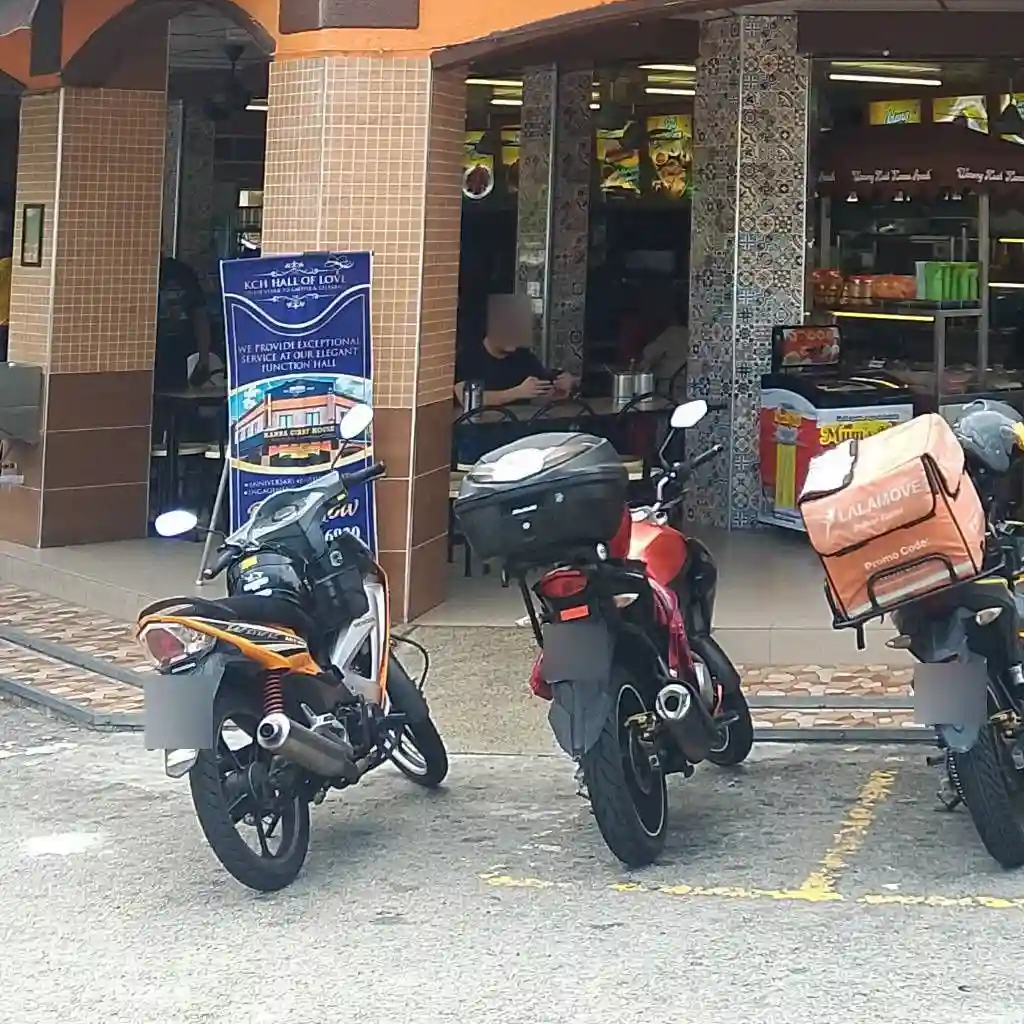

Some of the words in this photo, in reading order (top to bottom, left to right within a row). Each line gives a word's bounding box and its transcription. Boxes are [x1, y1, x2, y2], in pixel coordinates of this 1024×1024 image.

[272, 277, 299, 288] HALL
[300, 276, 316, 286] OF
[319, 275, 346, 285] LOVE
[238, 344, 252, 354] WE
[255, 341, 295, 352] PROVIDE
[297, 336, 361, 349] EXCEPTIONAL
[240, 352, 277, 364] SERVICE
[280, 352, 291, 361] AT
[293, 350, 314, 360] OUR
[316, 346, 358, 358] ELEGANT
[262, 361, 310, 373] FUNCTION
[313, 358, 336, 369] HALL
[838, 479, 923, 522] LALAMOVE
[864, 551, 899, 570] Promo
